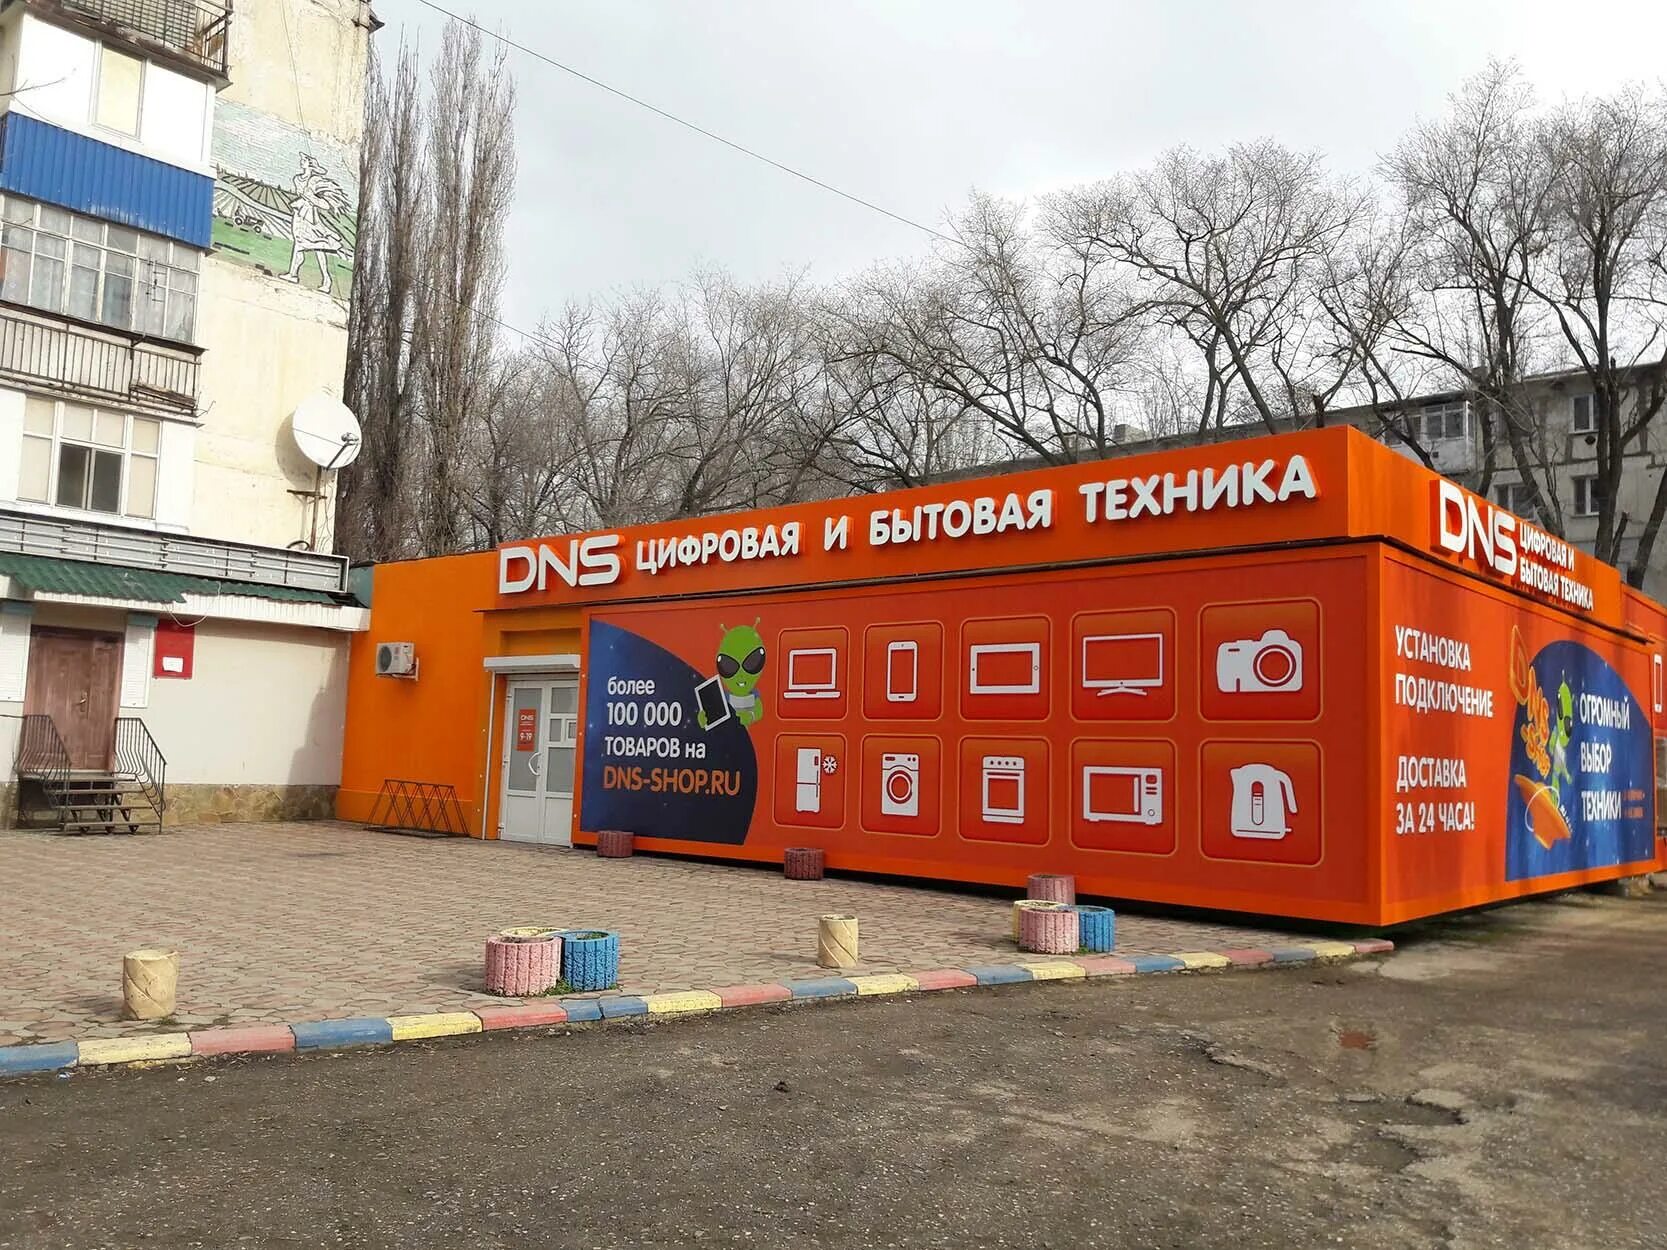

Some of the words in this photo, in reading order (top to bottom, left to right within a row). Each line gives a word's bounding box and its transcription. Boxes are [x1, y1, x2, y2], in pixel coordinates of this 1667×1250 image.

[499, 534, 621, 594] DNS
[636, 521, 800, 575] ЦИФРОВАЯ
[823, 515, 848, 551] И
[869, 489, 1053, 546] БЫТОВАЯ
[1078, 454, 1318, 523] ТЕХНИКА
[1439, 479, 1517, 576] DNS
[1519, 520, 1567, 566] ЦИФРОВАЯ
[1567, 545, 1576, 572] И
[1519, 556, 1559, 597] БЫТОВАЯ
[1559, 575, 1594, 611] ТЕХНИКА
[1395, 624, 1472, 672] УСТАНОВКА
[607, 676, 655, 695] более
[1395, 672, 1494, 719] ПОДКЛЮЧЕНИЕ
[607, 702, 638, 726] 100
[643, 702, 682, 727] 000
[1579, 692, 1630, 731] ОГРОМНЫЙ
[604, 736, 680, 758] ТОВАРОВ
[685, 742, 706, 759] на
[1580, 741, 1612, 774] ВЫБОР
[603, 766, 741, 796] DNS-SHOP.RU
[1396, 756, 1467, 792] ДОСТАВКА
[1396, 802, 1415, 834] ЗА
[1418, 802, 1435, 833] 24
[1438, 801, 1474, 831] ЧАСА!
[1581, 790, 1622, 822] ТЕХНИКИ
